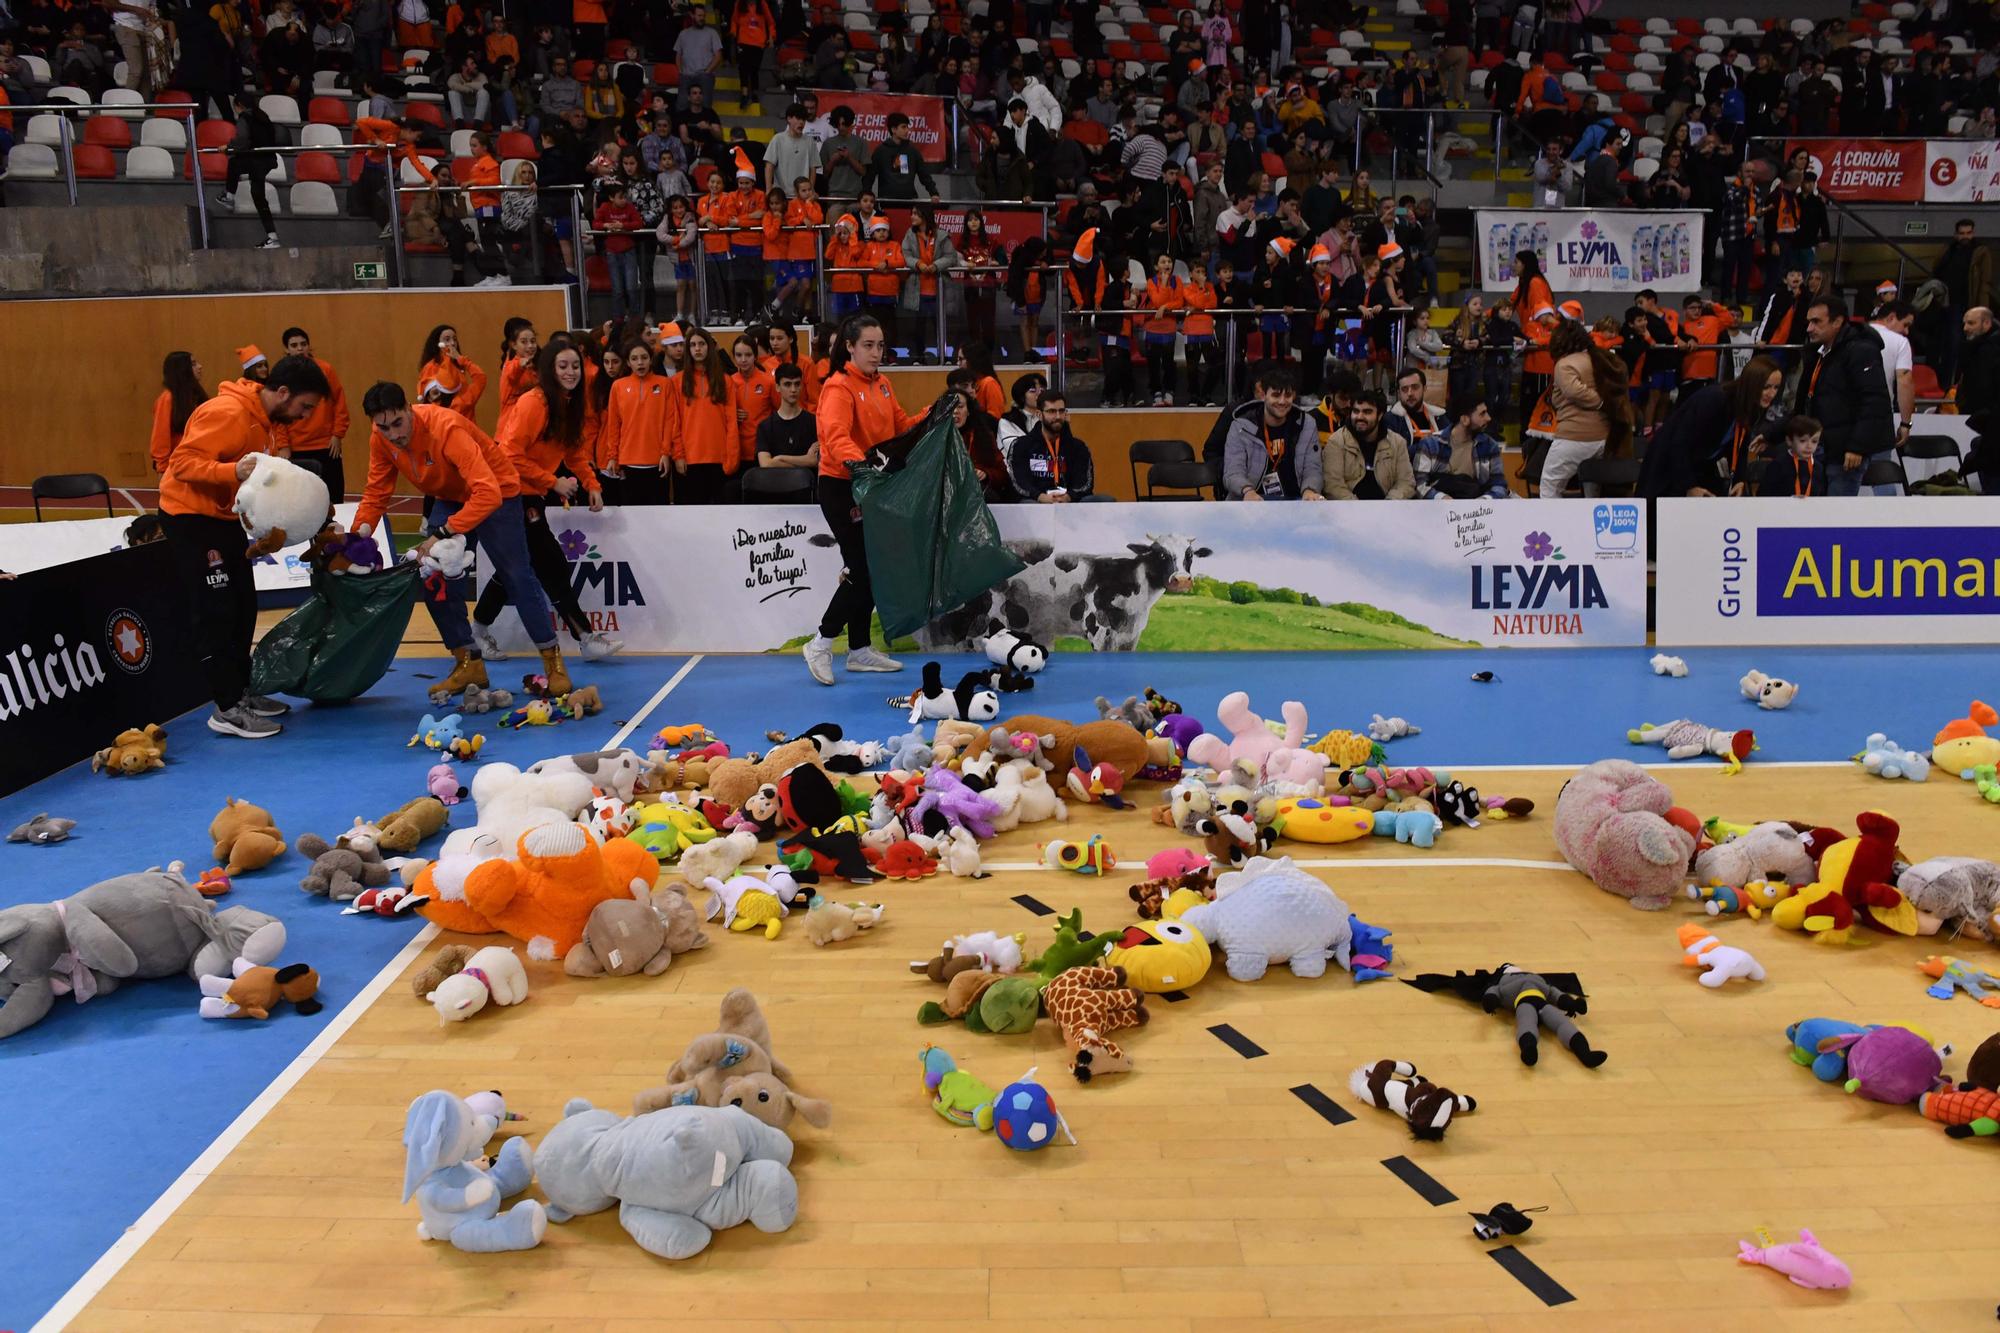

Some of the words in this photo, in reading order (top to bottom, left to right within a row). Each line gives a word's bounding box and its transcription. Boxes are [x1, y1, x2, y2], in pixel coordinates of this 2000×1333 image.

[865, 114, 887, 127] CHE
[1831, 151, 1842, 167] A
[1844, 149, 1900, 168] CORUÑA
[1830, 167, 1842, 186] É
[1840, 170, 1904, 187] DEPORTE
[1557, 241, 1622, 265] LEYMA
[1569, 267, 1609, 278] NATURA
[1463, 505, 1493, 519] nuestra
[1614, 518, 1635, 526] 100%
[732, 528, 756, 551] ¡De
[759, 520, 806, 543] nuestra
[1457, 519, 1485, 538] familia
[1462, 535, 1471, 546] la
[750, 542, 794, 573] familia
[745, 578, 756, 588] a
[758, 567, 773, 585] la
[773, 558, 808, 585] tuya!
[1718, 528, 1747, 617] Grupo
[1472, 565, 1609, 609] LEYMA
[1493, 613, 1583, 636] NATURA
